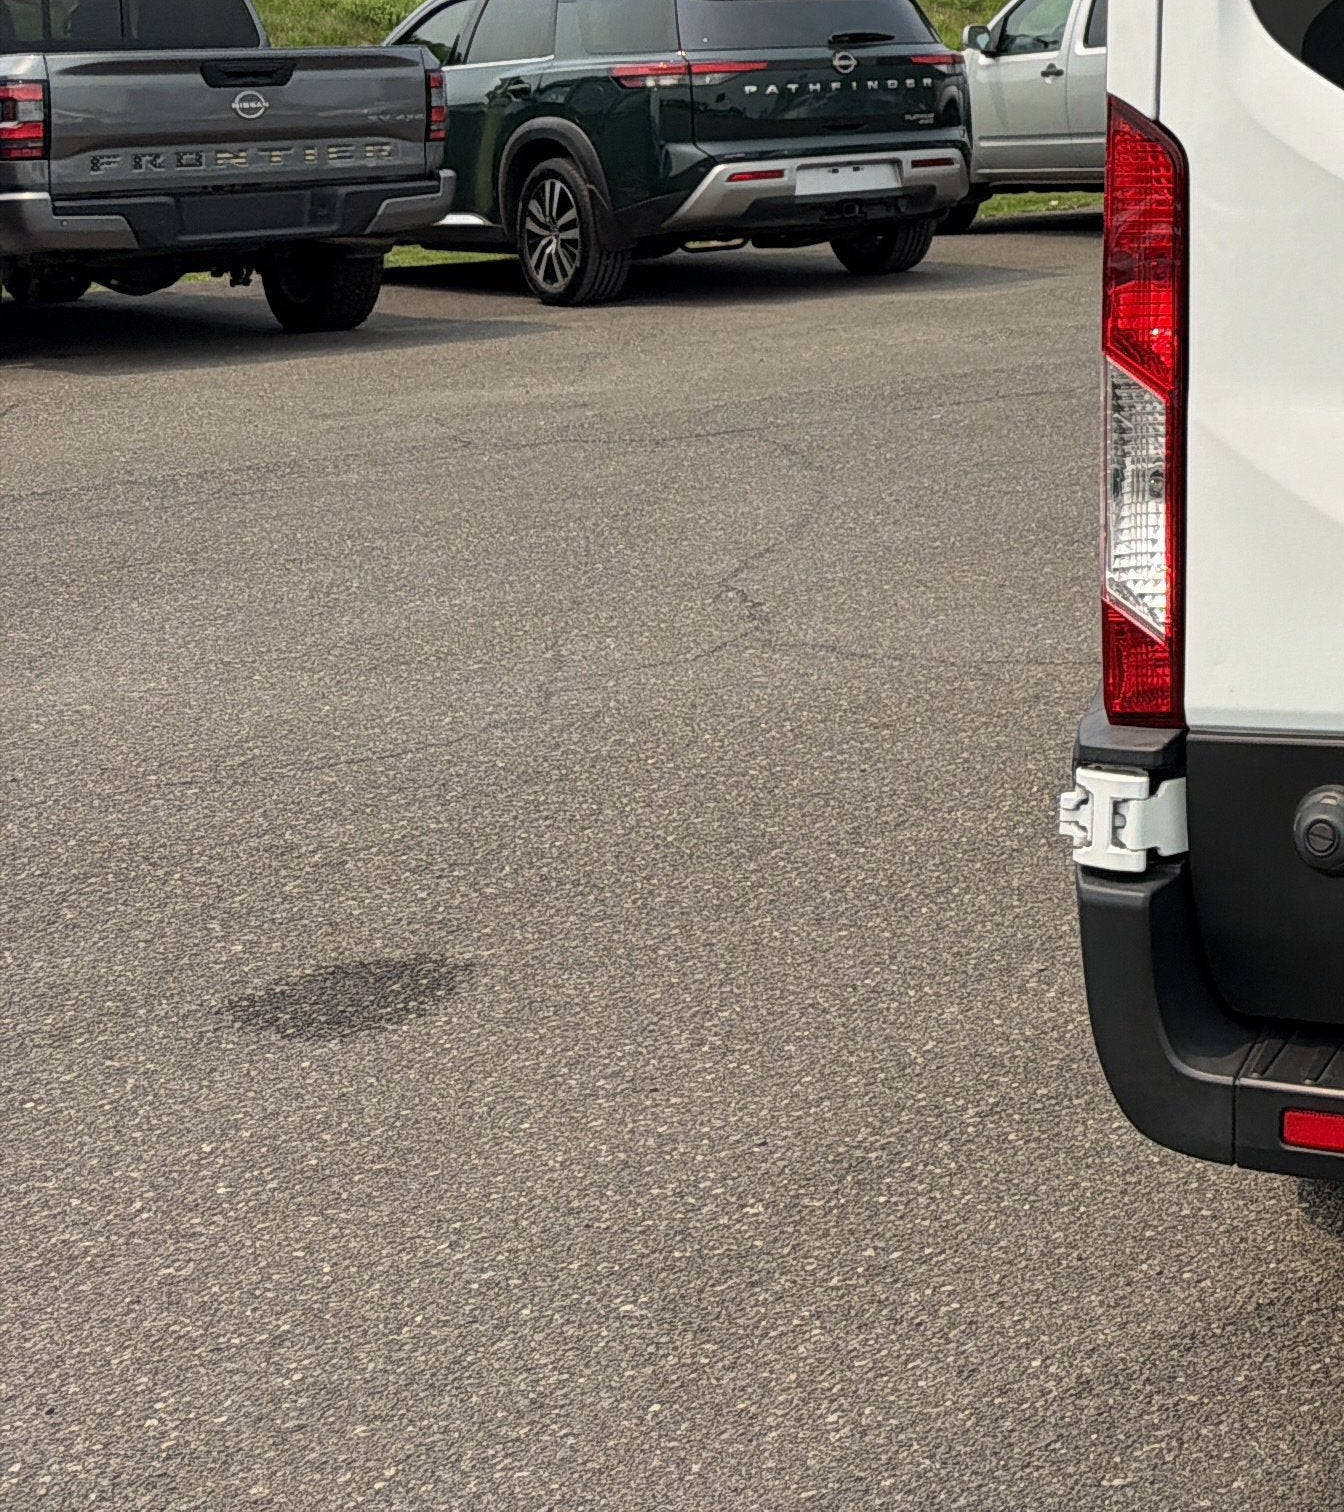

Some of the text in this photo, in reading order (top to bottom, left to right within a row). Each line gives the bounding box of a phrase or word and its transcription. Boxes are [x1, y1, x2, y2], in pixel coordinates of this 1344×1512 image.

[744, 77, 932, 95] PATHFINDER
[231, 101, 270, 109] NISSAN
[89, 144, 395, 176] FRONTIER
